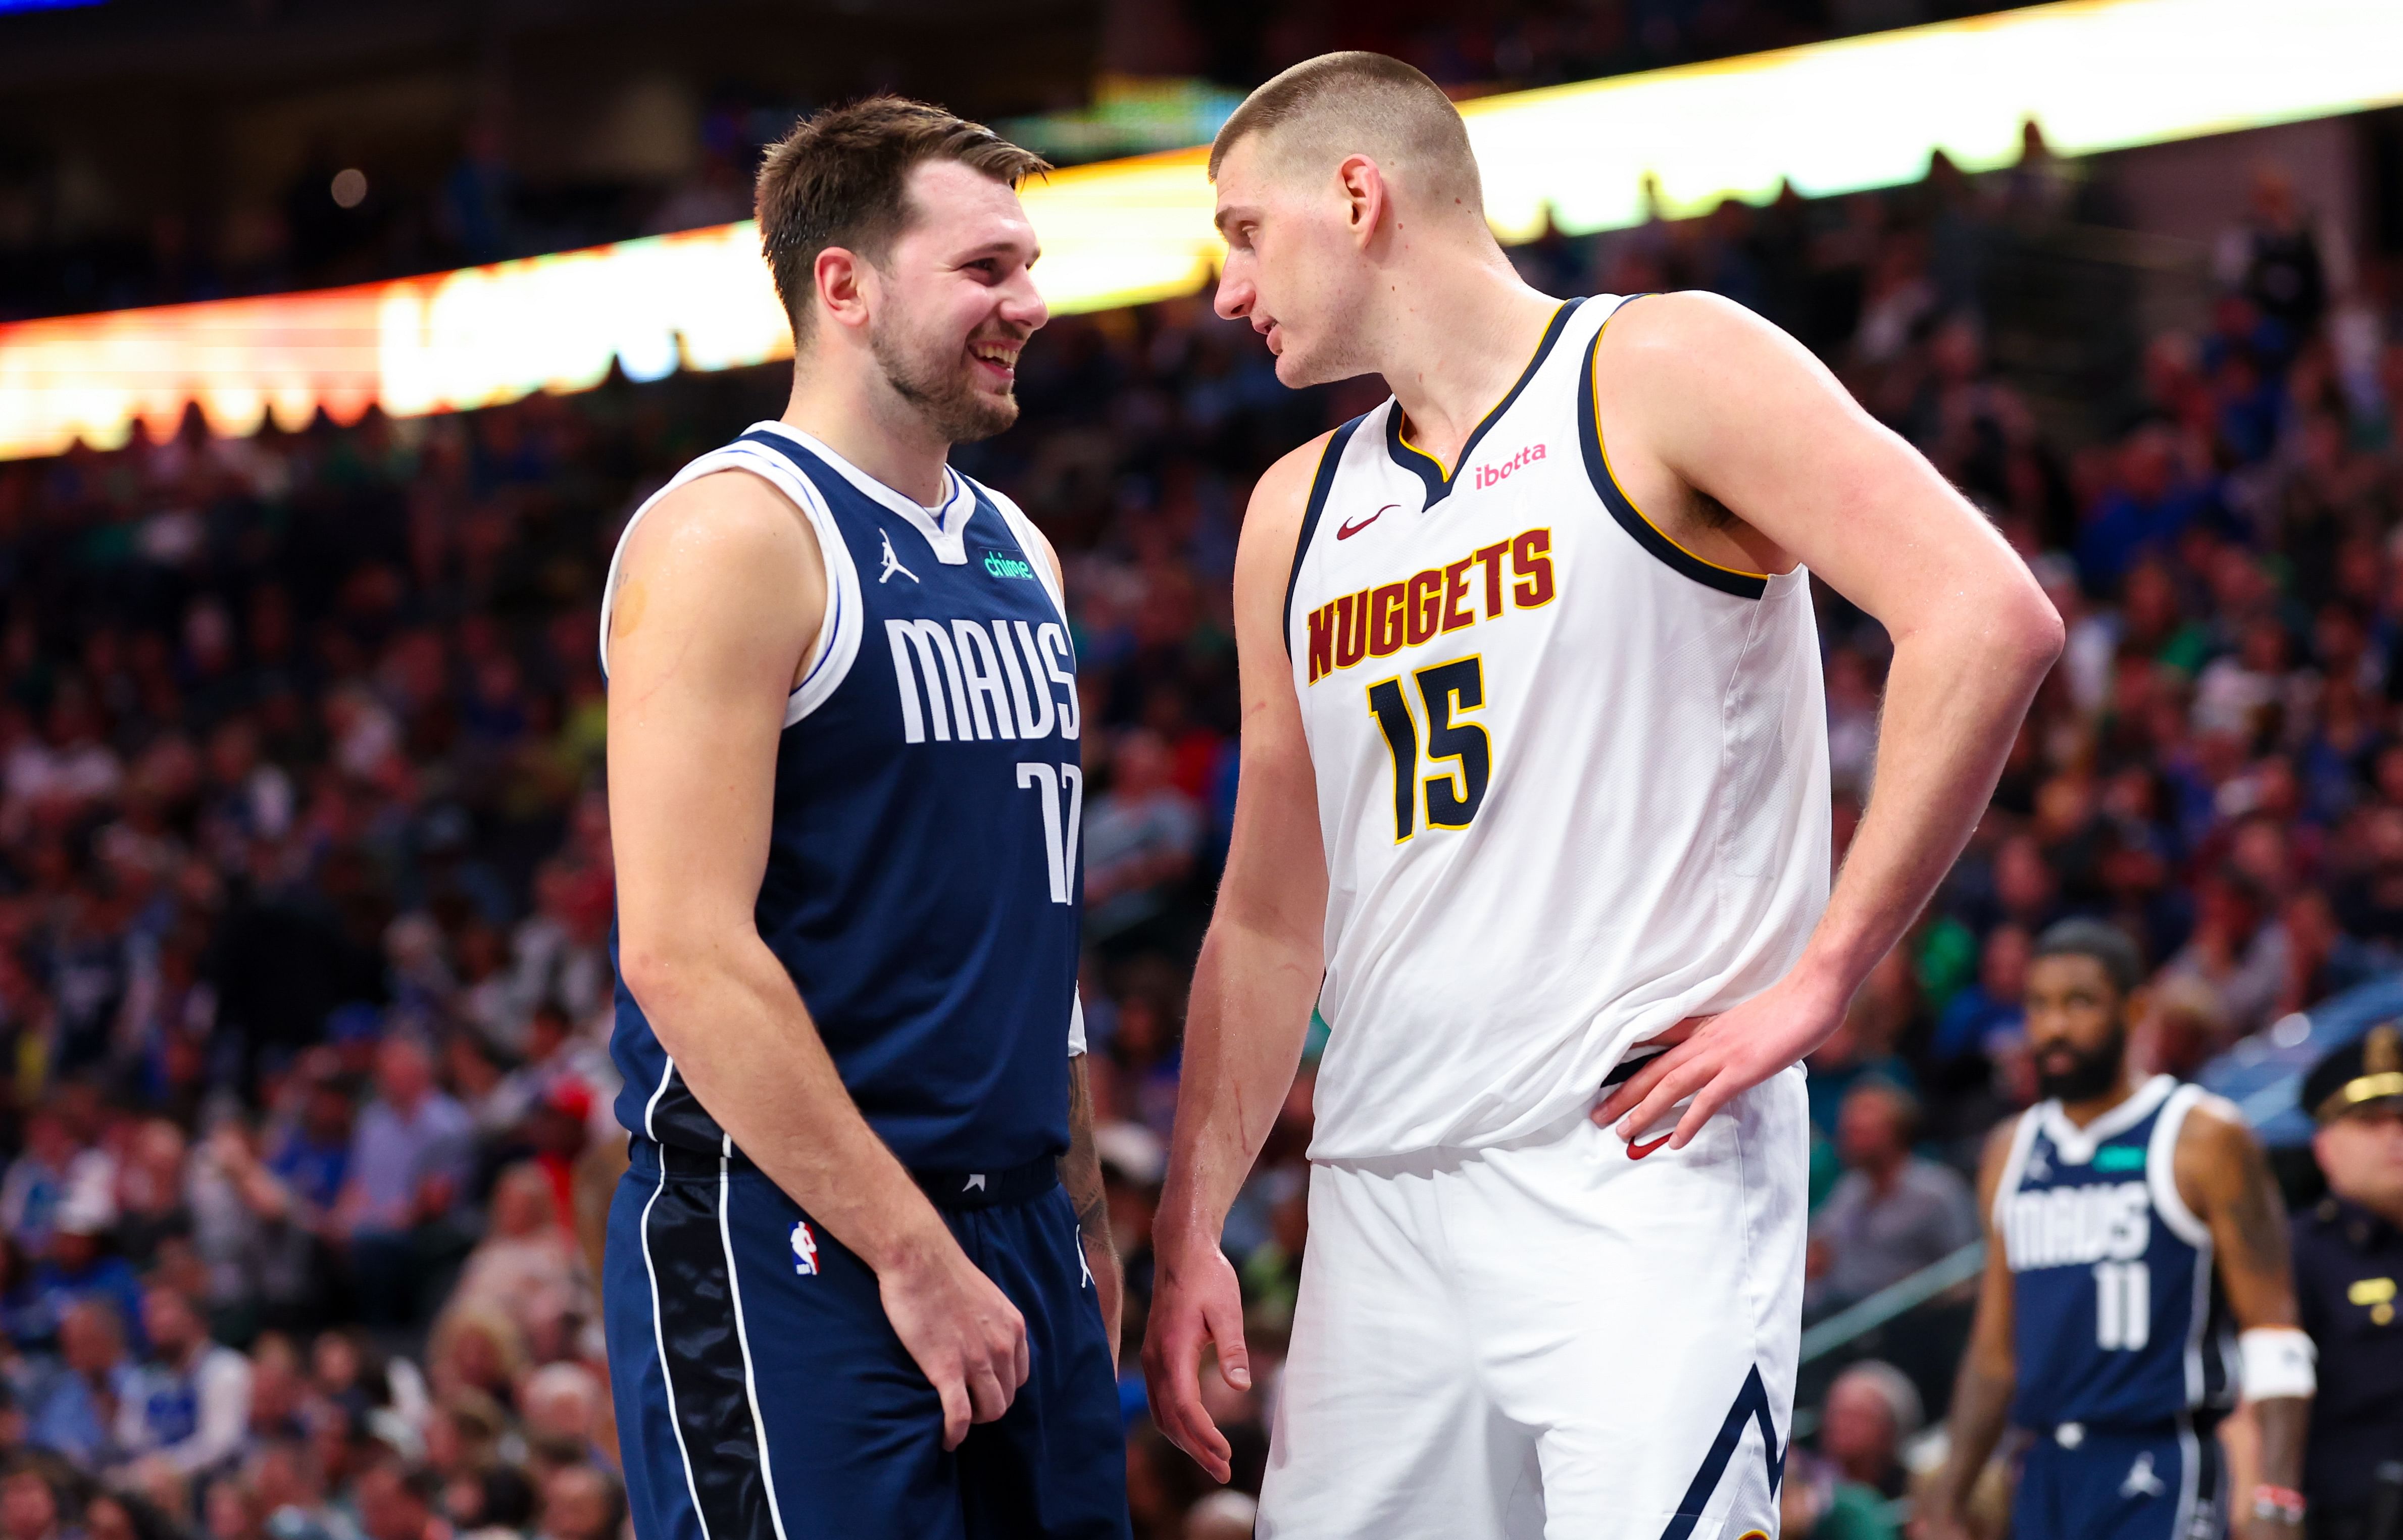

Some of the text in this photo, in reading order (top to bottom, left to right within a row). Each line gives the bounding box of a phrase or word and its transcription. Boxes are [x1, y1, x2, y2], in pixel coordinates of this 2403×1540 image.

[1476, 444, 1546, 490] ibotta
[984, 550, 1033, 579] chime
[1307, 527, 1557, 687] NUGGETS
[884, 619, 1080, 744] MAVS
[1366, 652, 1490, 845] 15
[2092, 1261, 2150, 1351] 11
